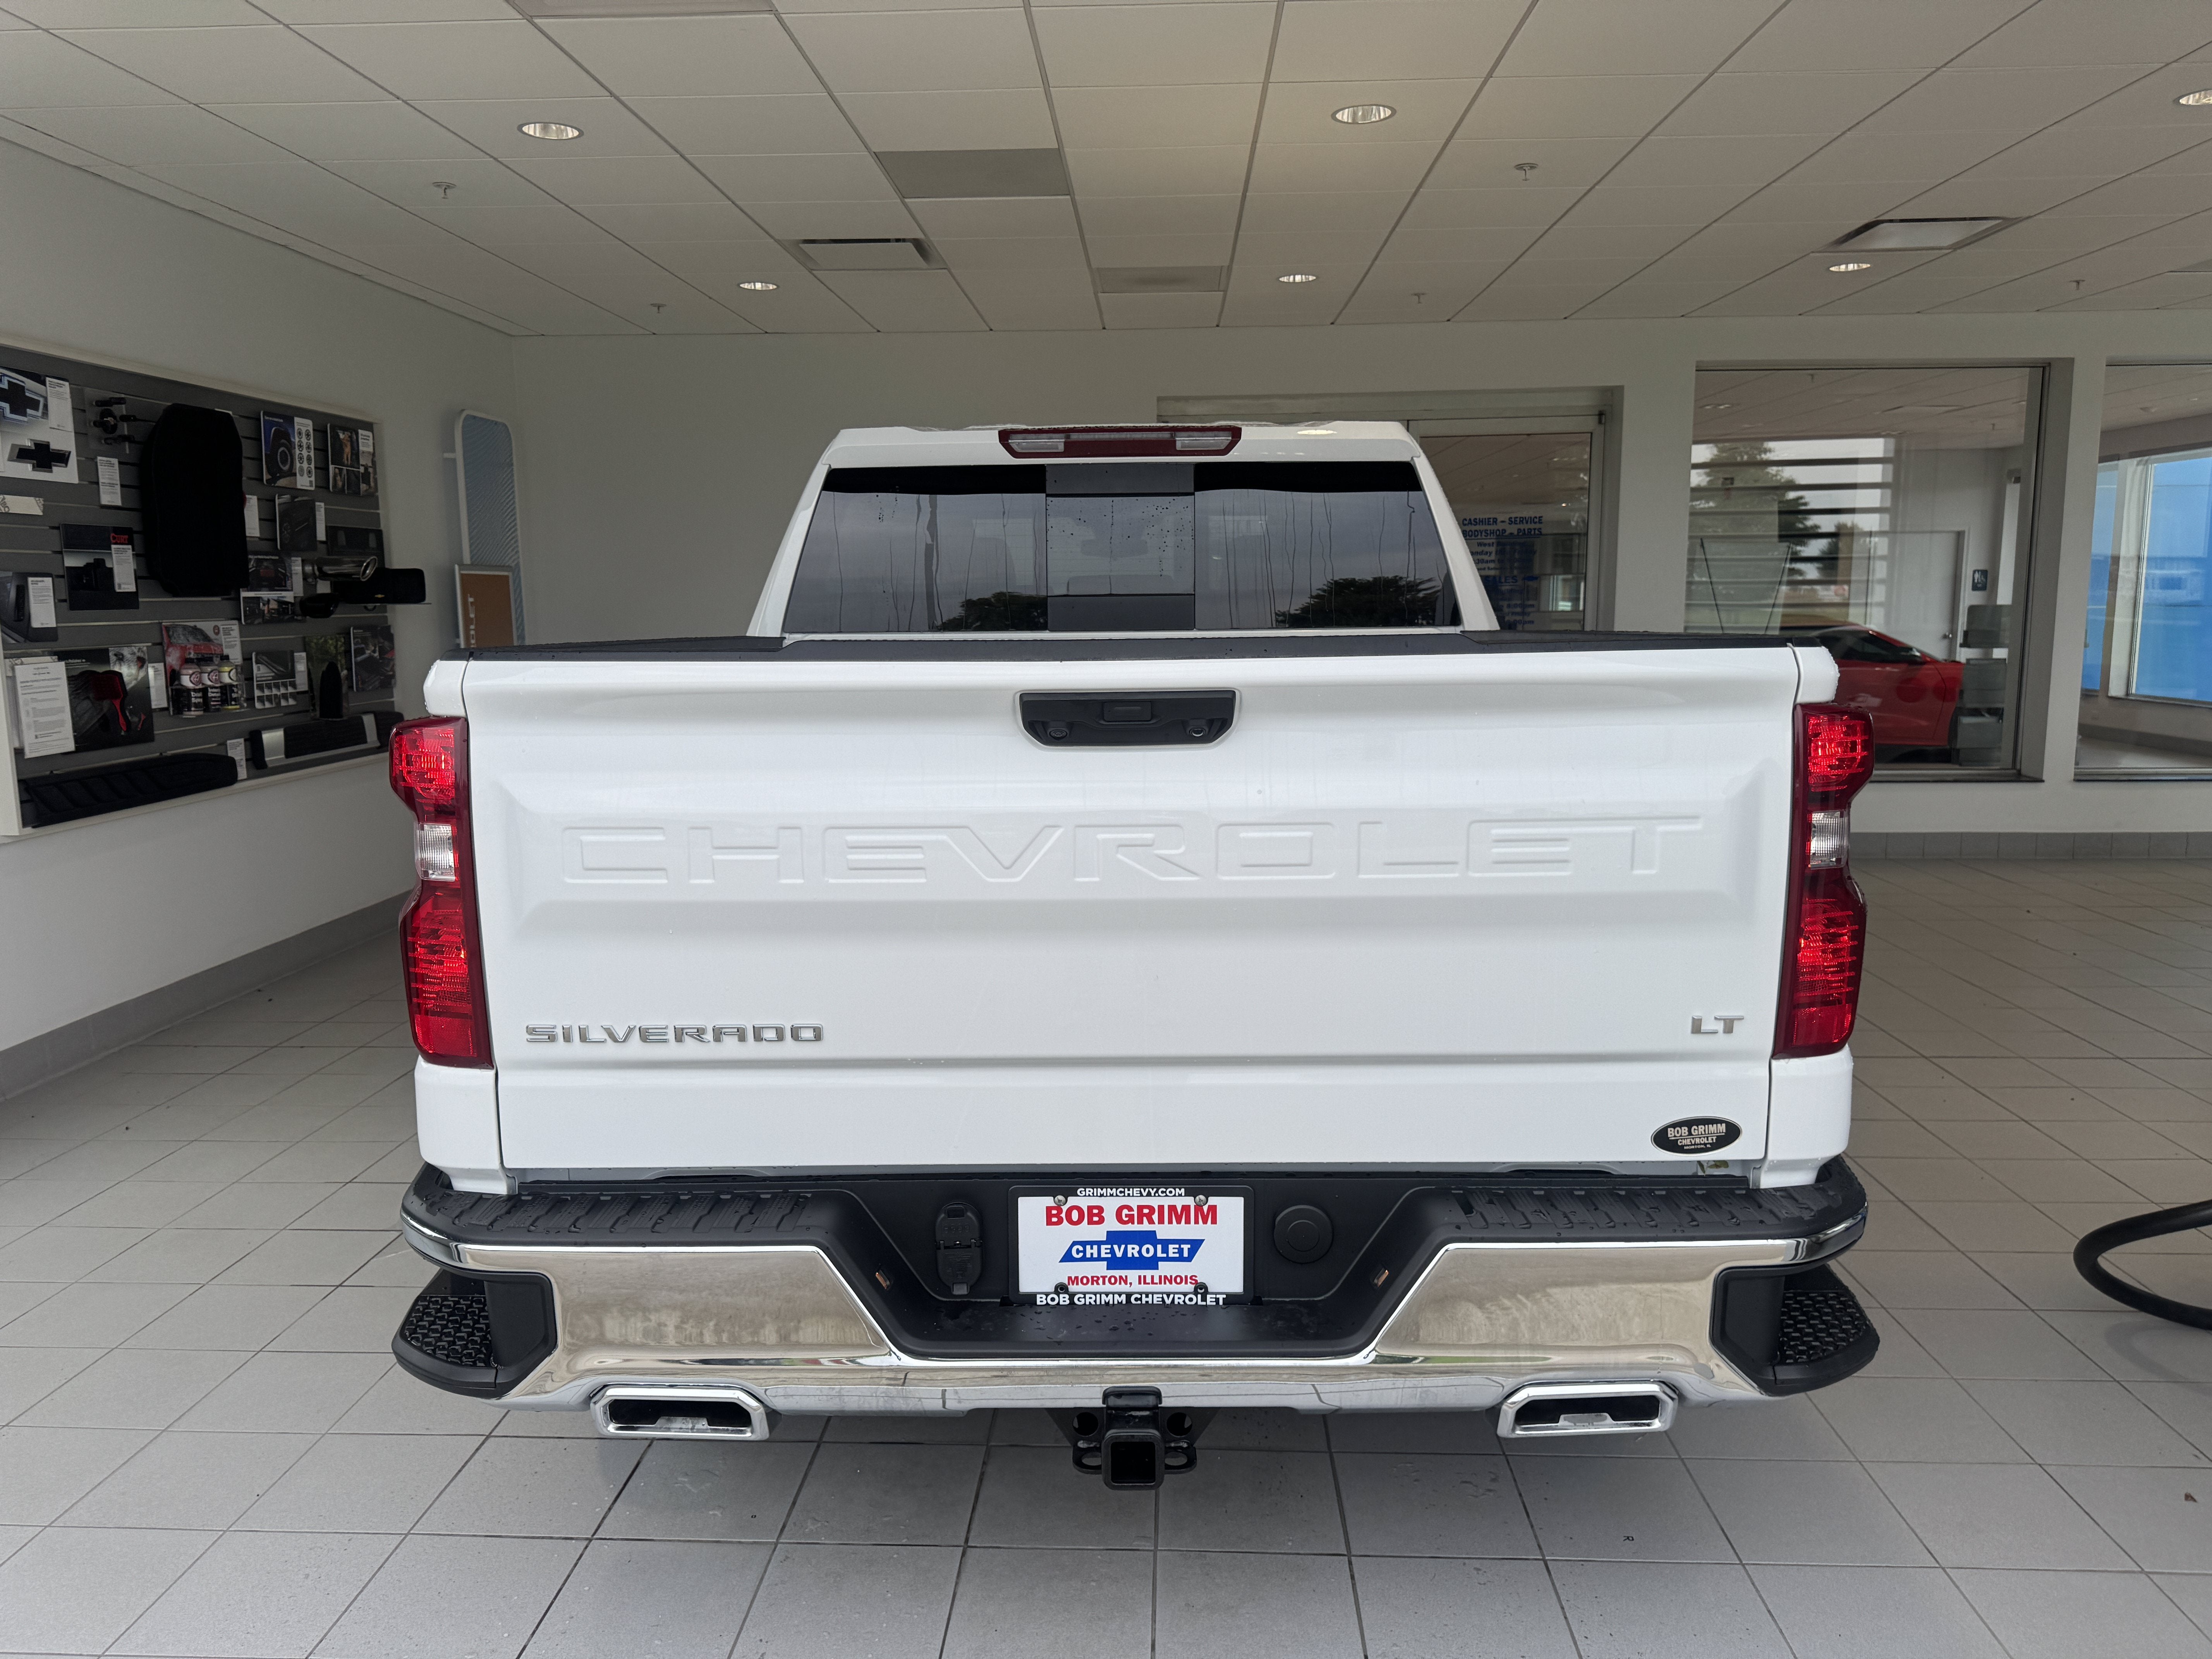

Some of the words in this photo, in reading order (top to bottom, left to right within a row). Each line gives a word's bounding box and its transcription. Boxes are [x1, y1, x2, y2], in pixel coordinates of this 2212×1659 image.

[1462, 517, 1498, 526] CASHIER
[1508, 516, 1543, 525] SERVICE
[1462, 529, 1506, 538] BODYSHOP
[1517, 528, 1542, 536] PARTS
[562, 816, 1702, 884] CHEVROLET
[1691, 1015, 1745, 1034] LT
[526, 1023, 824, 1044] SILVERADO
[1668, 1127, 1688, 1137] BOB
[1691, 1123, 1726, 1135] GRIMM
[1678, 1136, 1716, 1146] CHEVROLET
[1077, 1188, 1185, 1197] GRIMMCHEVY.COM
[1045, 1205, 1105, 1226] BOB
[1115, 1204, 1218, 1226] GRIMM
[1071, 1244, 1191, 1258] CHEVROLET
[1067, 1275, 1132, 1288] MORTON,
[1138, 1274, 1198, 1286] ILLINOIS
[1036, 1294, 1069, 1305] BOB
[1074, 1294, 1127, 1305] GRIMM
[1130, 1294, 1226, 1305] CHEVROLET
